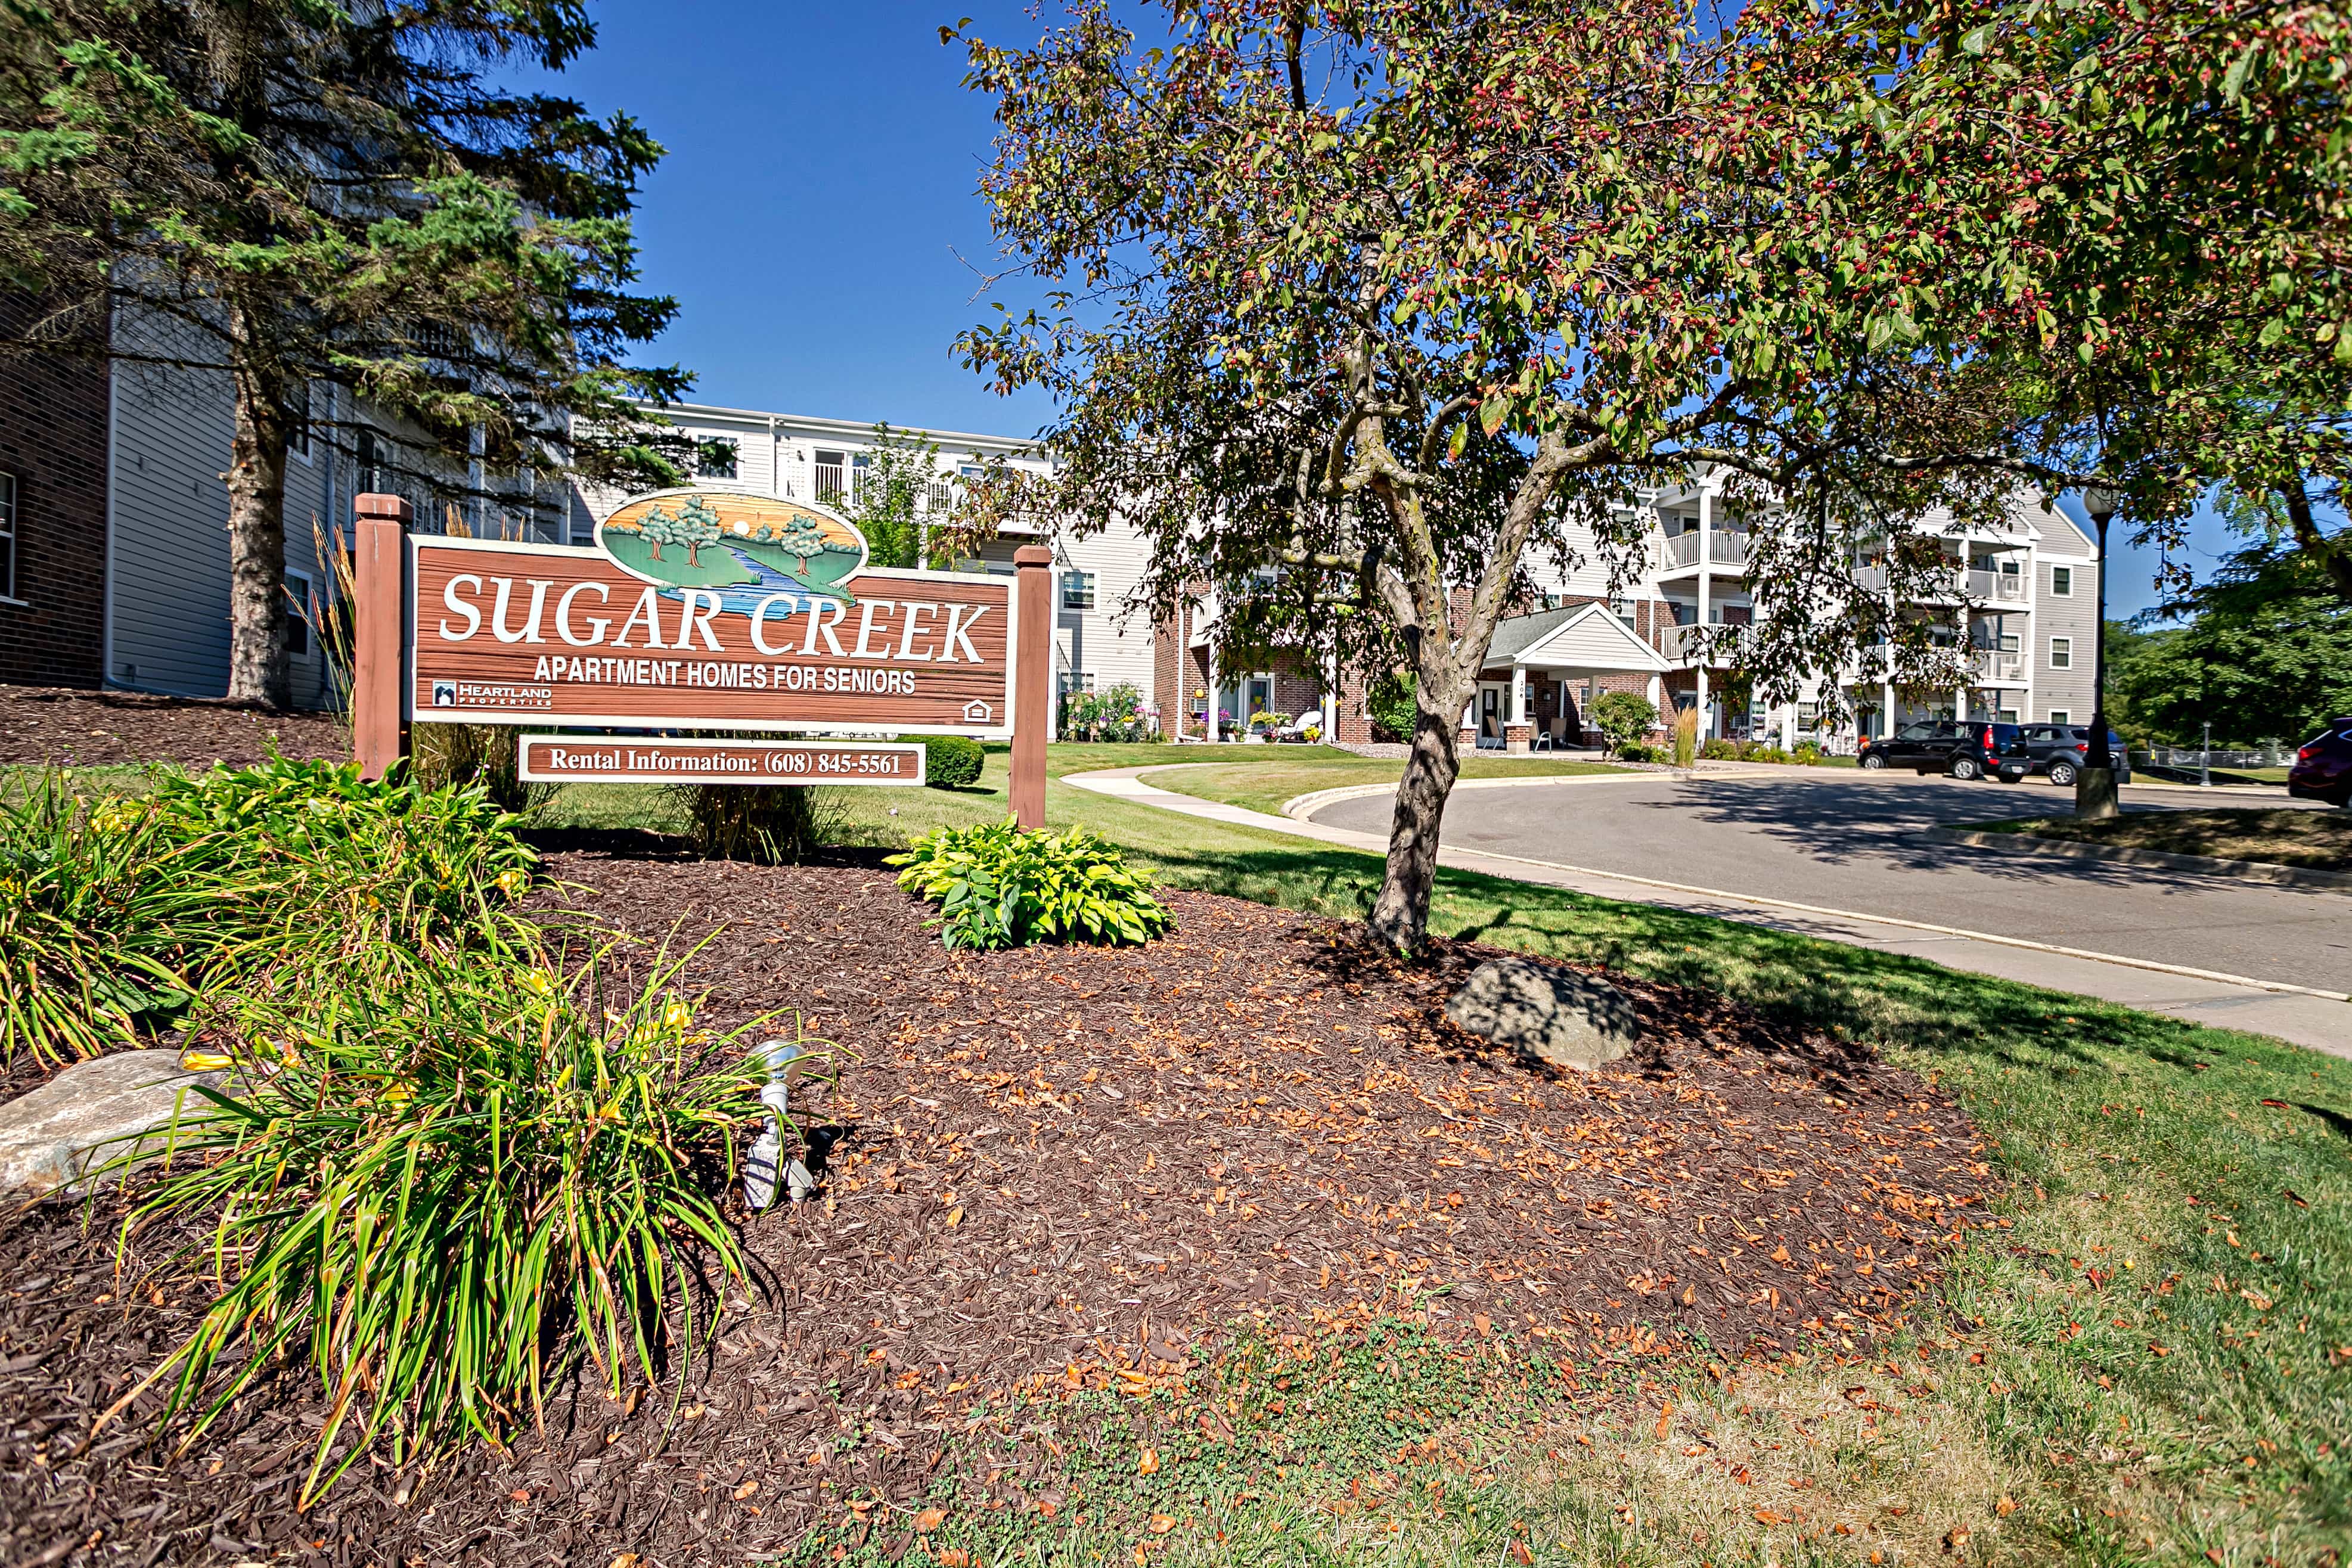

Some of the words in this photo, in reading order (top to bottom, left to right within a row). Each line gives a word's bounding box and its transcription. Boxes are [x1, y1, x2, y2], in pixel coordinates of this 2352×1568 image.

[439, 573, 725, 652] SUGAR
[750, 593, 991, 664] CREEK
[533, 655, 682, 685] APARTMENT
[687, 662, 767, 689] HOMES
[774, 664, 817, 690] FOR
[823, 667, 916, 694] SENIORS
[459, 684, 552, 698] HEARTLAND
[459, 697, 552, 706] PROPERTIES
[549, 749, 620, 770] Rental
[627, 750, 757, 772] Information:
[764, 752, 812, 774] (608)
[818, 753, 901, 774] 845-5561
